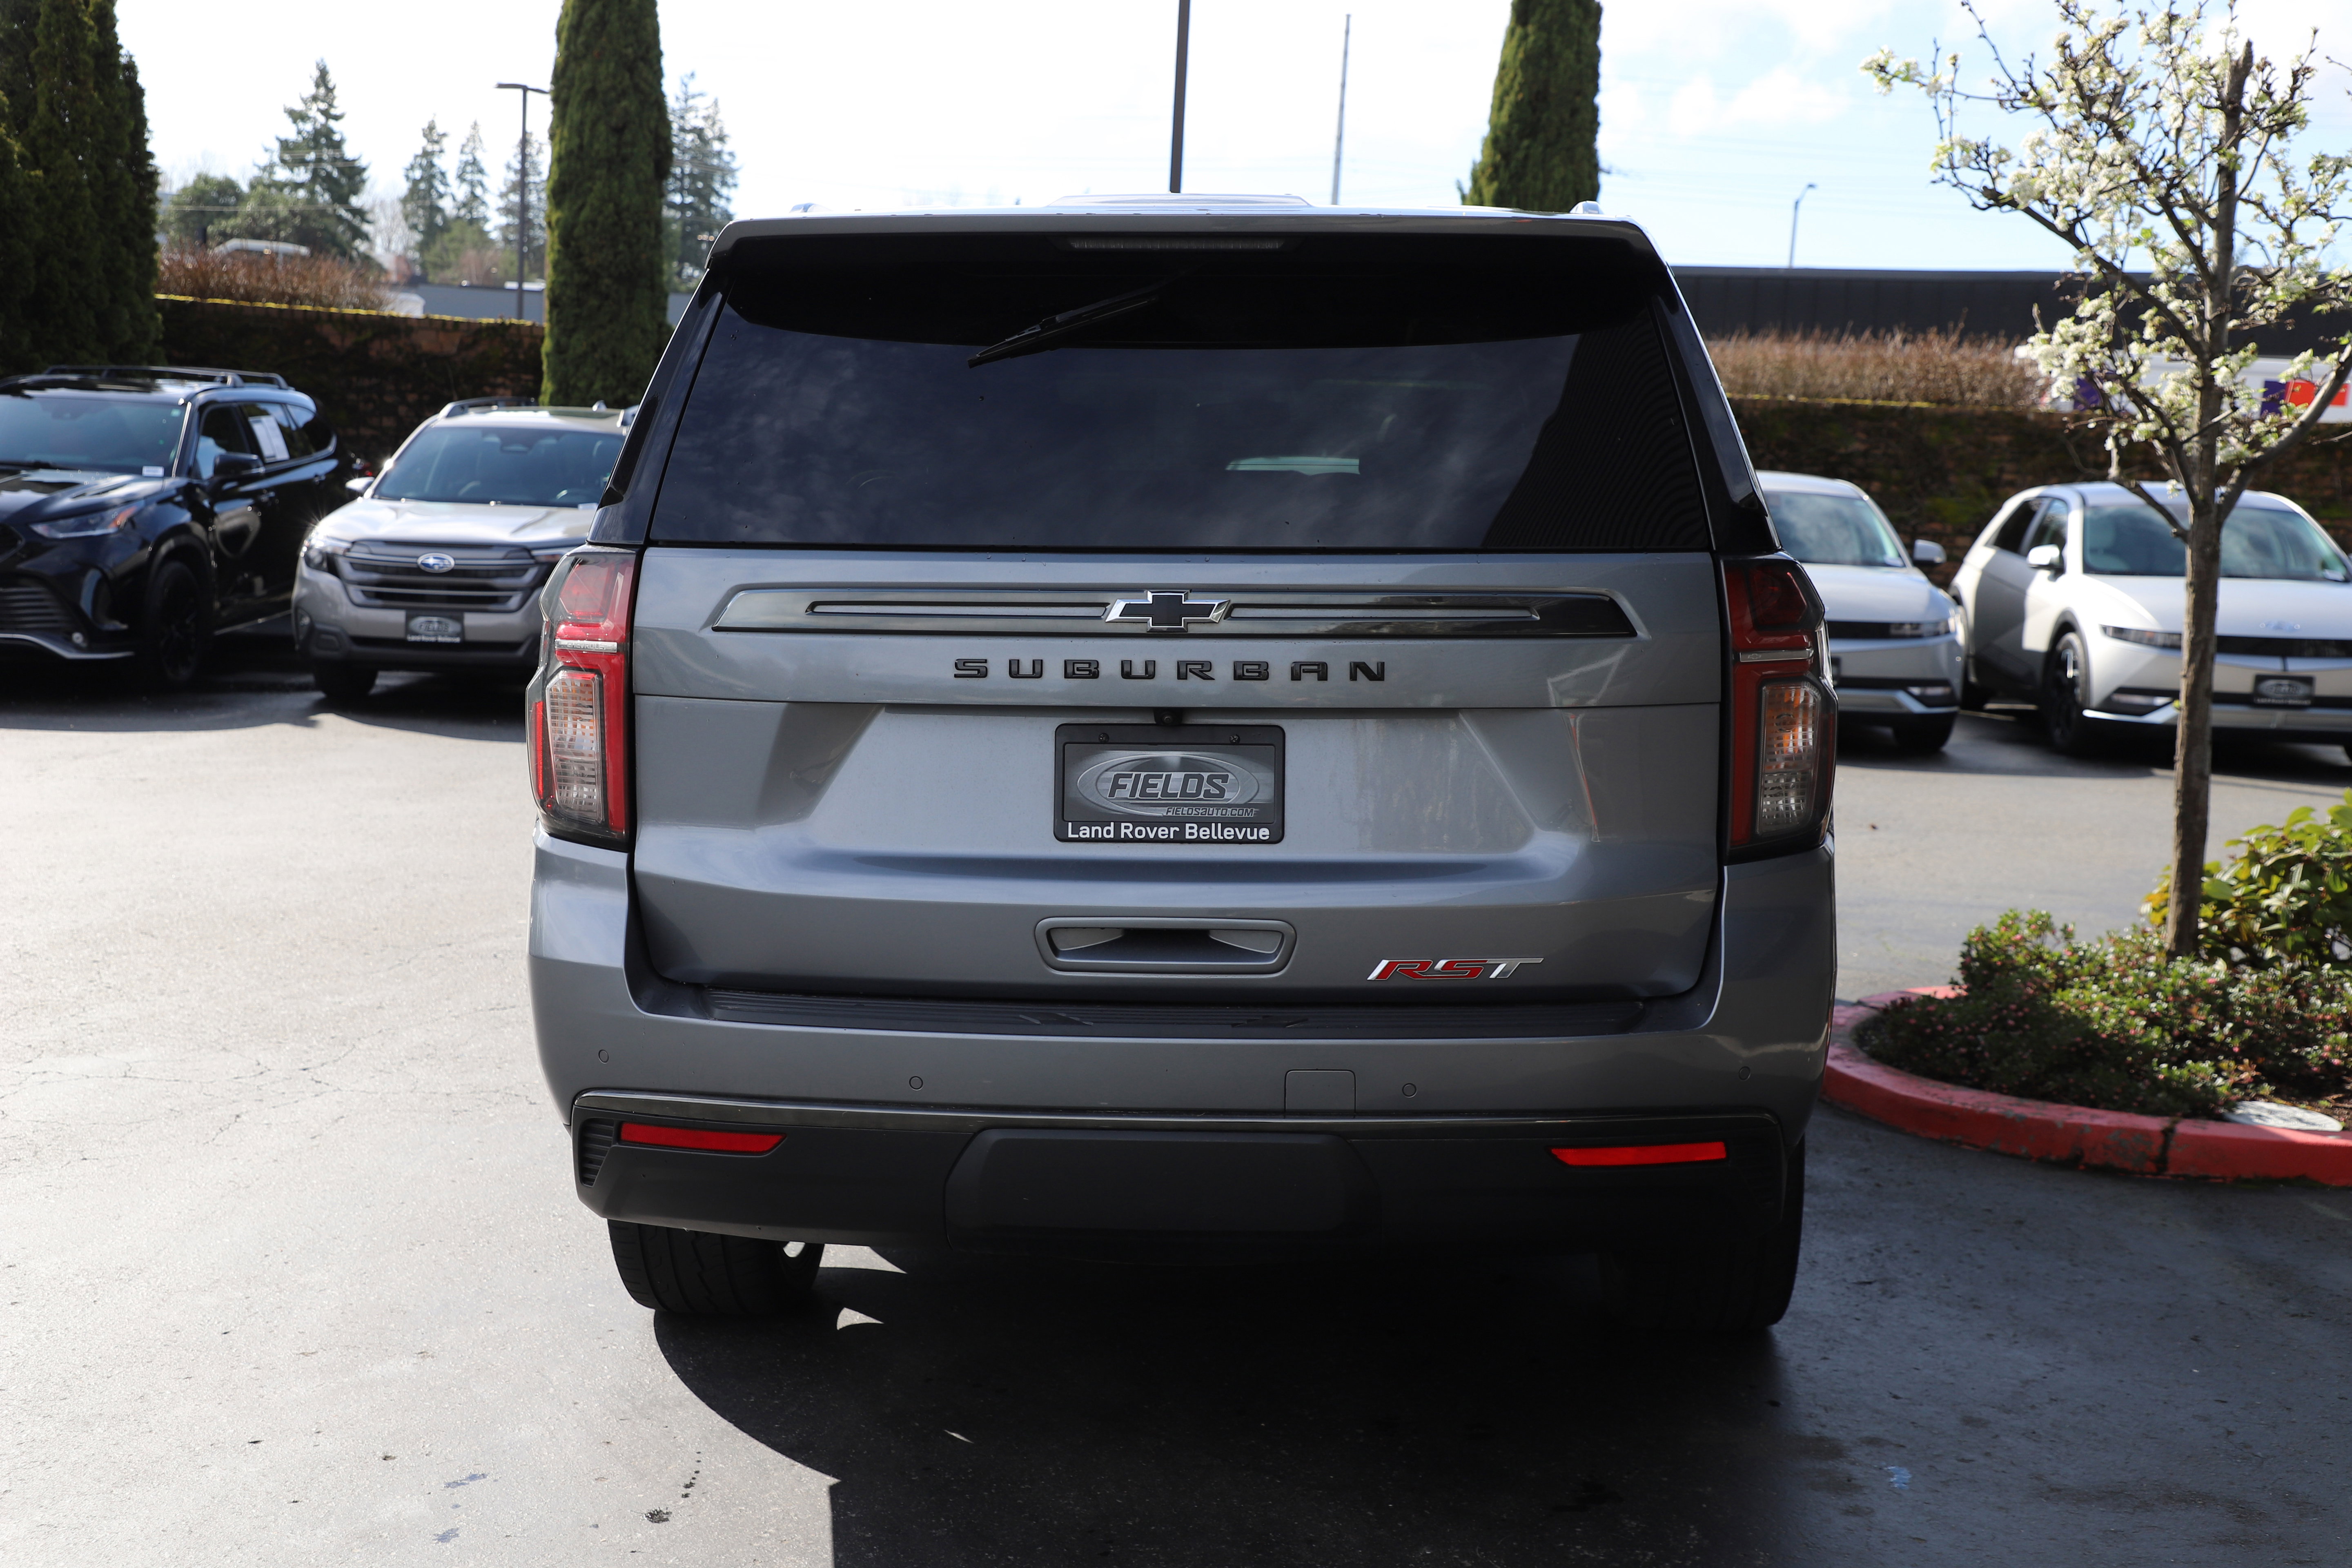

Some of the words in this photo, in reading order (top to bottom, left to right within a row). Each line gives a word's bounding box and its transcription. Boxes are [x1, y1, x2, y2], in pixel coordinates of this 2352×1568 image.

[954, 658, 1385, 682] SUBURBAN
[1107, 773, 1229, 799] FIELDS
[1067, 822, 1114, 839] Land
[1120, 823, 1179, 839] Rover
[1185, 823, 1270, 840] Bellevue
[1367, 958, 1544, 980] RST
